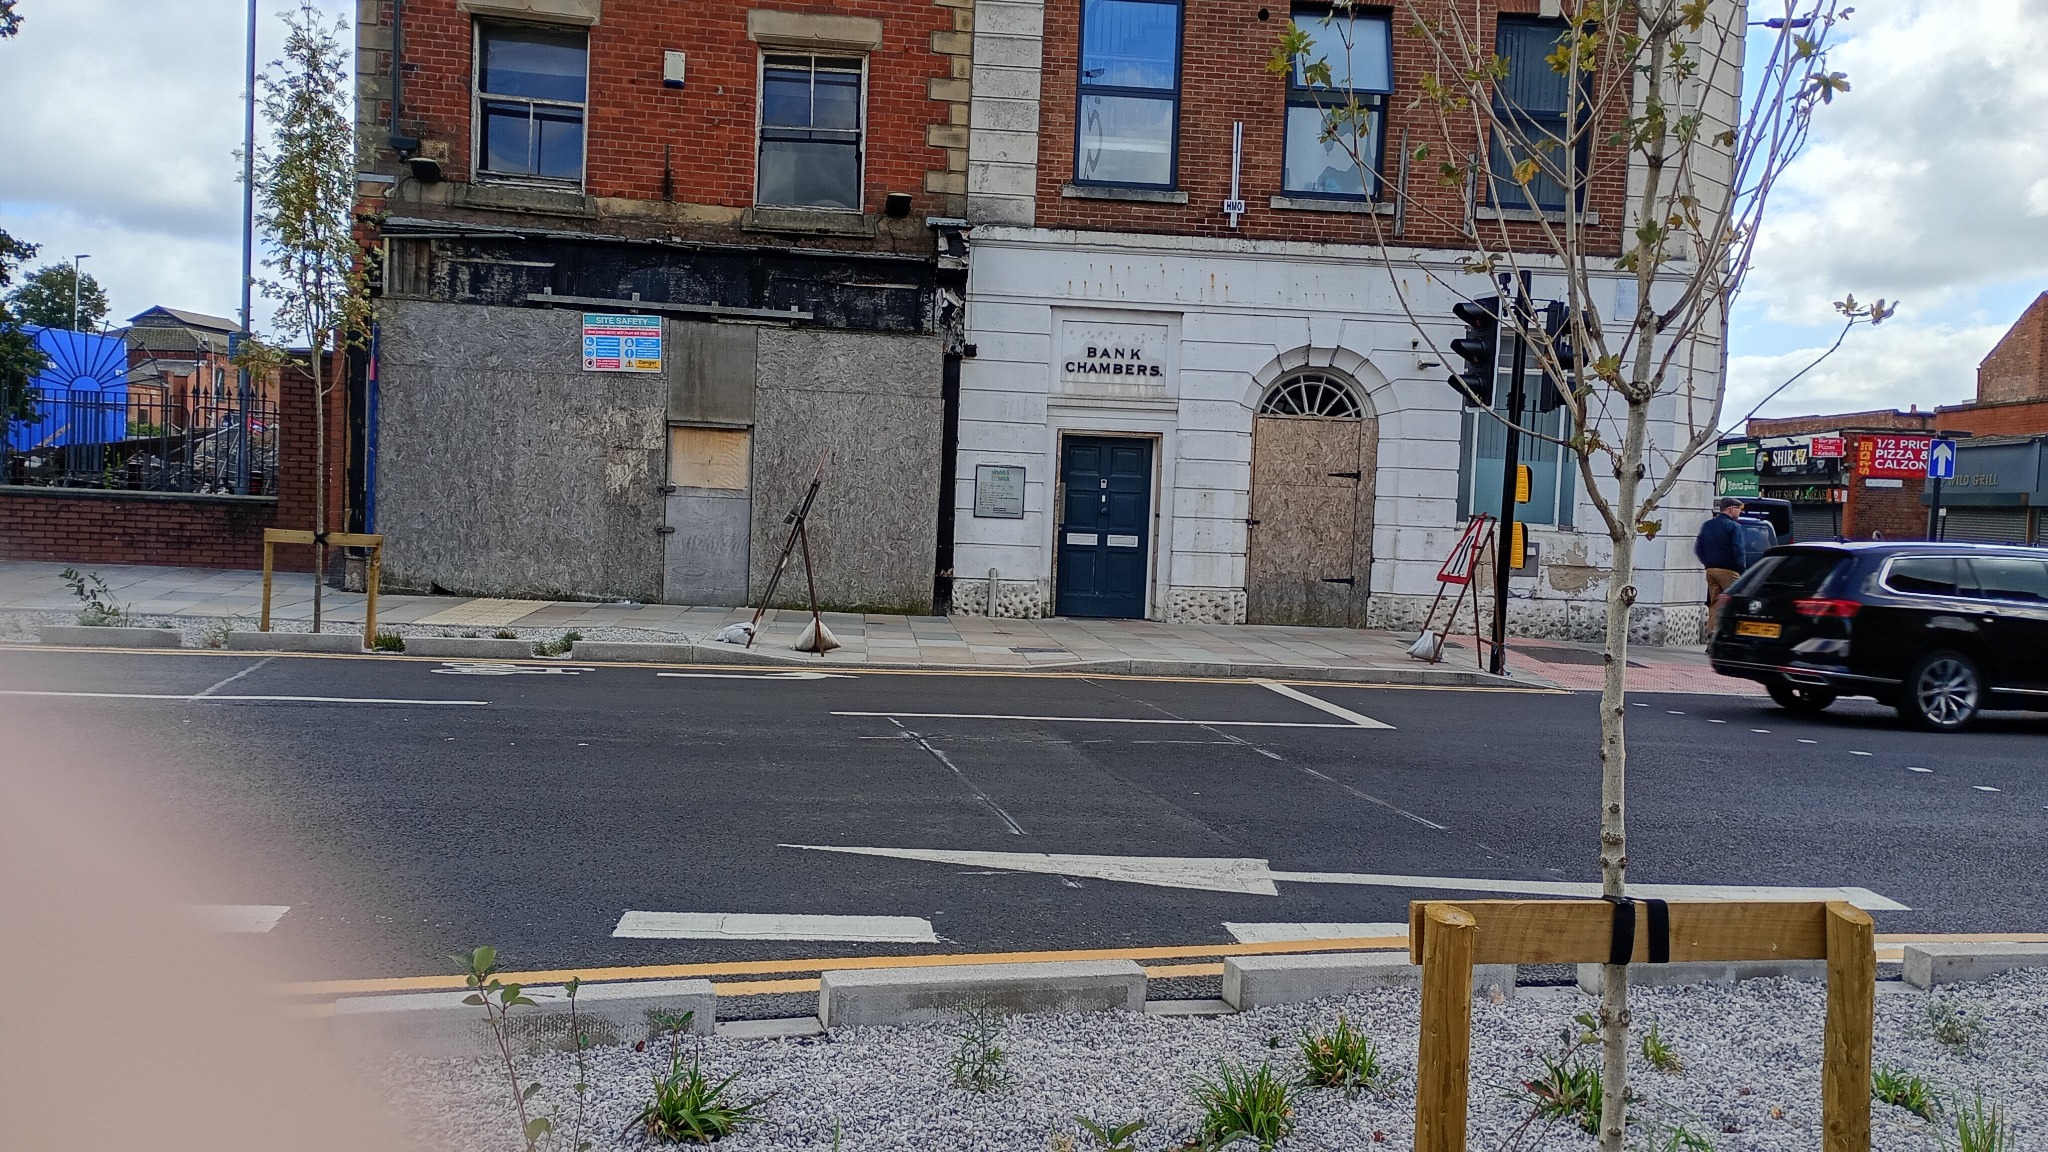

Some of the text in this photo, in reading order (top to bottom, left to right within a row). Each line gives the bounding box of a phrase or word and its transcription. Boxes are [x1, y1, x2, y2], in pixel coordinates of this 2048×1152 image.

[596, 316, 648, 325] SITE SAFETY
[1087, 347, 1141, 360] BANK
[1065, 362, 1163, 376] CHAMBERS.
[1876, 438, 1929, 449] 1/2 PRIC
[1772, 449, 1807, 467] SHIRAZ
[1875, 449, 1928, 460] PIZZA &
[1874, 460, 1927, 470] CALZON
[1972, 473, 1998, 486] GRILL
